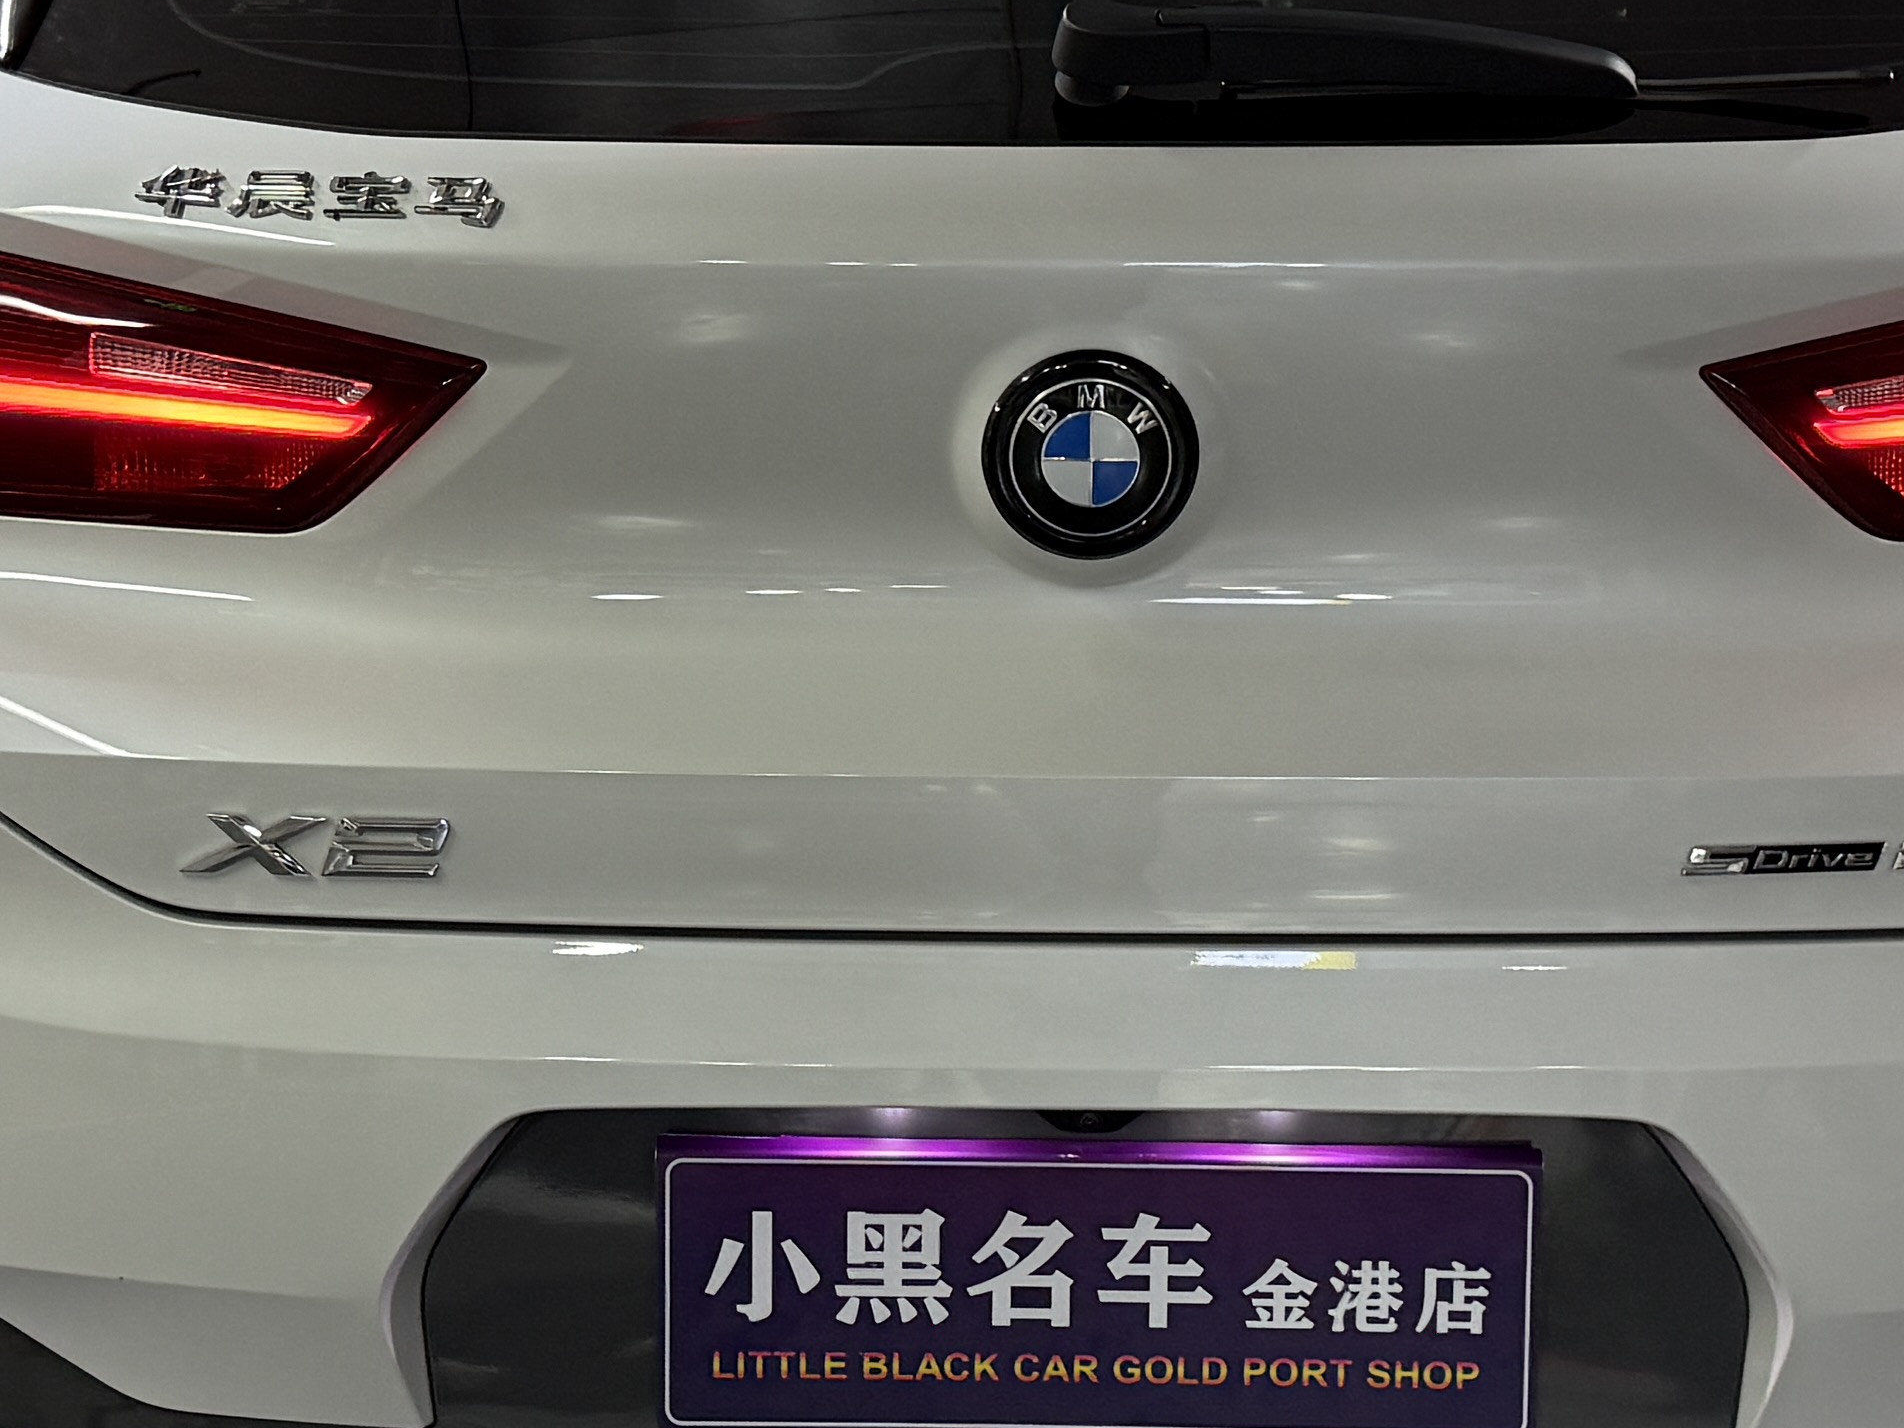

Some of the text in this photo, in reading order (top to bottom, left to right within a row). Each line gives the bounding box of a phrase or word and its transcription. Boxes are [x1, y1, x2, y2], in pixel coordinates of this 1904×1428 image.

[1026, 383, 1159, 435] BMW
[179, 812, 450, 877] X2
[704, 1208, 1493, 1335] 小黑名车 金港店
[712, 1350, 1480, 1390] LITTLE BLACK CAR GOLD PORT SHOP
